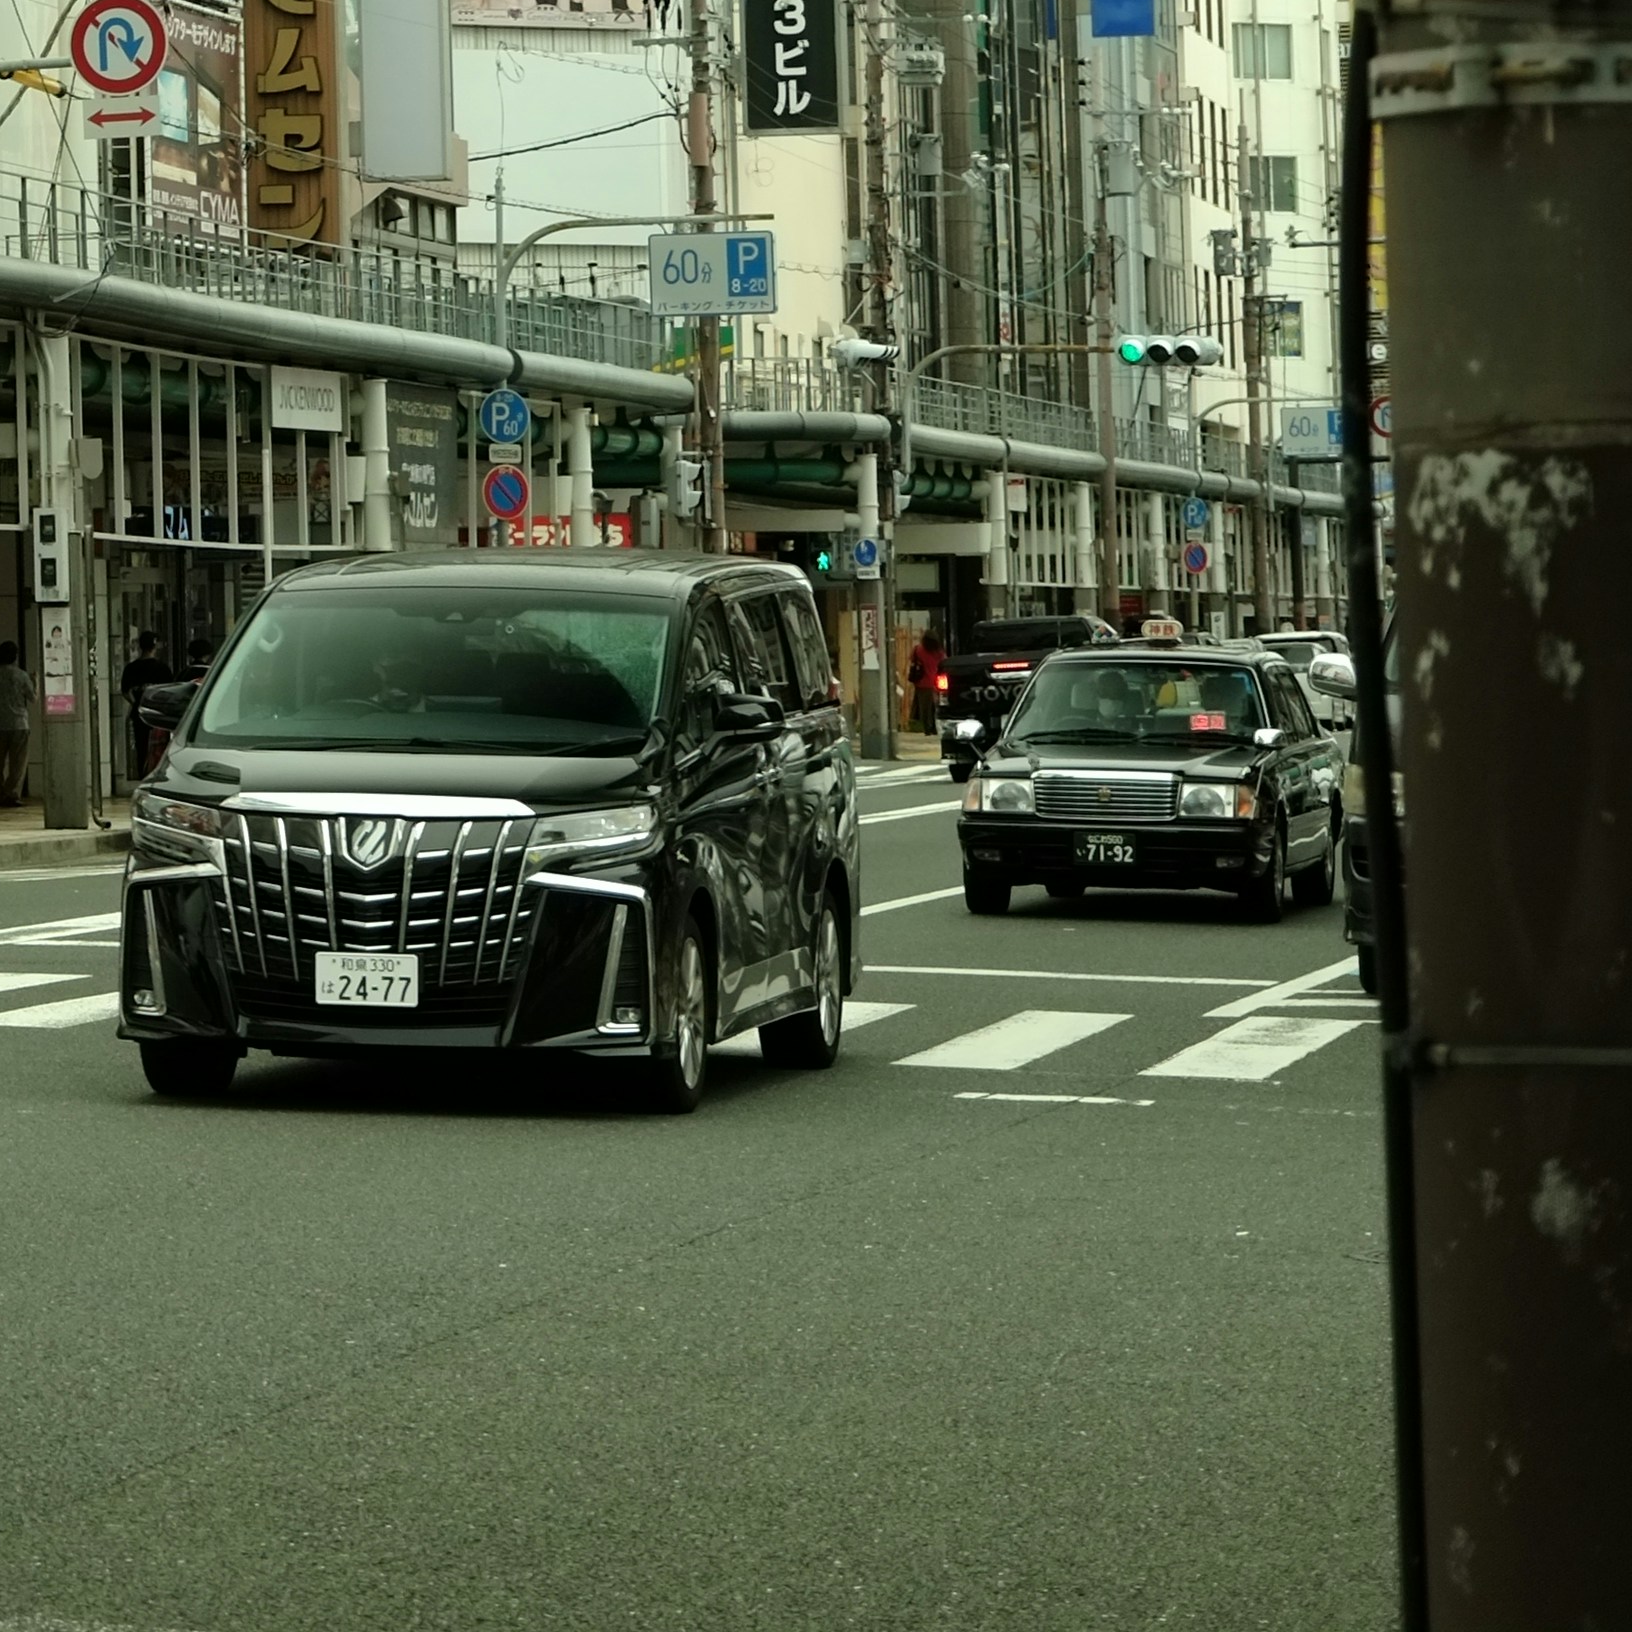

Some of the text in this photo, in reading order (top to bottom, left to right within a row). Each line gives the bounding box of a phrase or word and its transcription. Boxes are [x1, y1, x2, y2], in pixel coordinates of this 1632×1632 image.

[663, 249, 713, 285] 60分
[738, 241, 759, 275] P
[731, 278, 767, 293] 8-20
[492, 402, 510, 436] P
[973, 685, 1024, 701] TOYO
[1087, 844, 1134, 863] 71-92
[321, 975, 412, 1003] は 24-77
